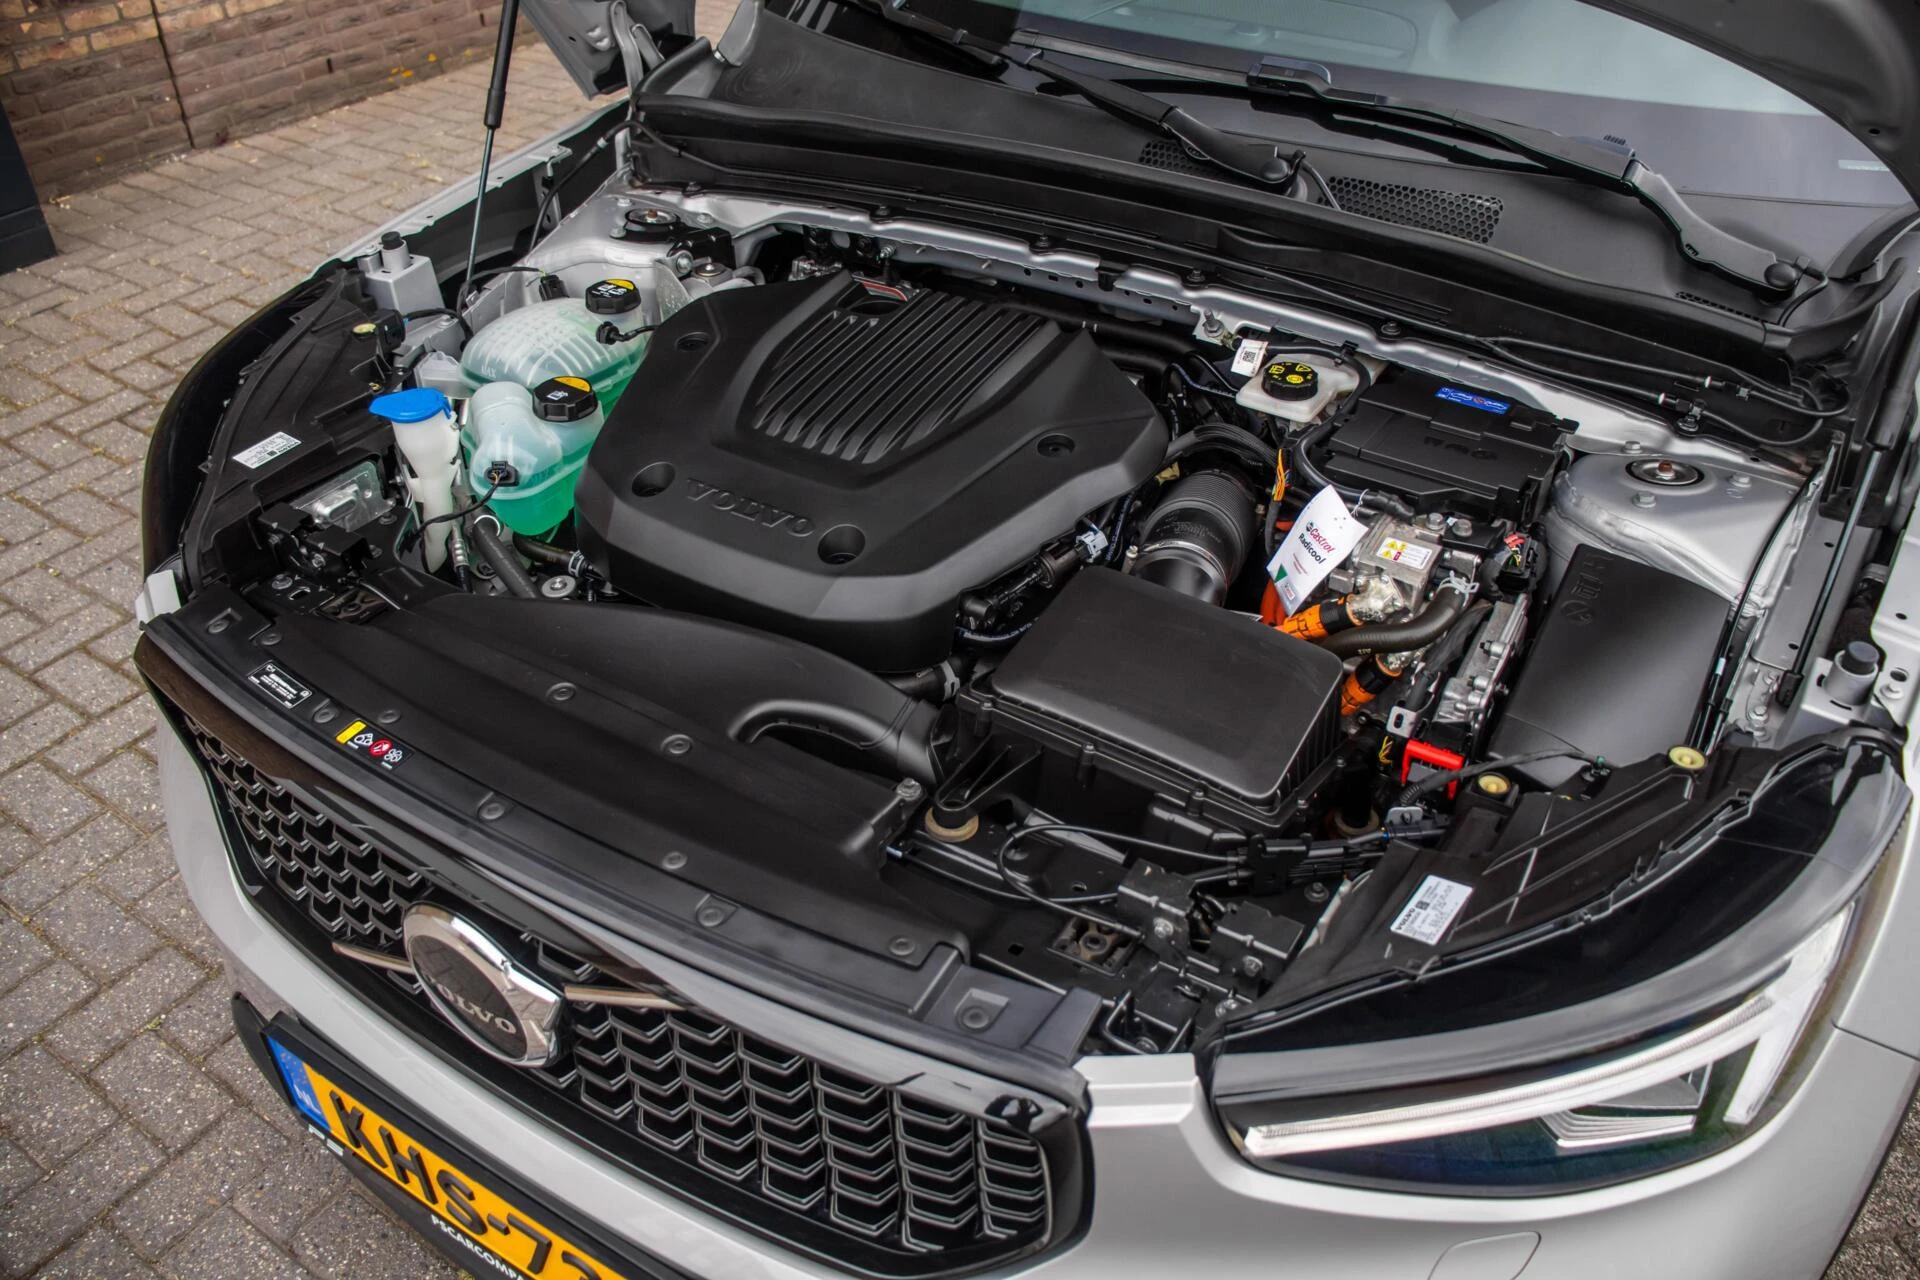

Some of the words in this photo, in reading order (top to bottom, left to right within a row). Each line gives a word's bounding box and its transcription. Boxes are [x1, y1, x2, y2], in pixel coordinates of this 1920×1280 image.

[686, 477, 815, 538] VOLVO
[1298, 533, 1327, 565] Radicool
[1309, 527, 1337, 554] Castrol
[329, 1089, 603, 1280] KHS-7
